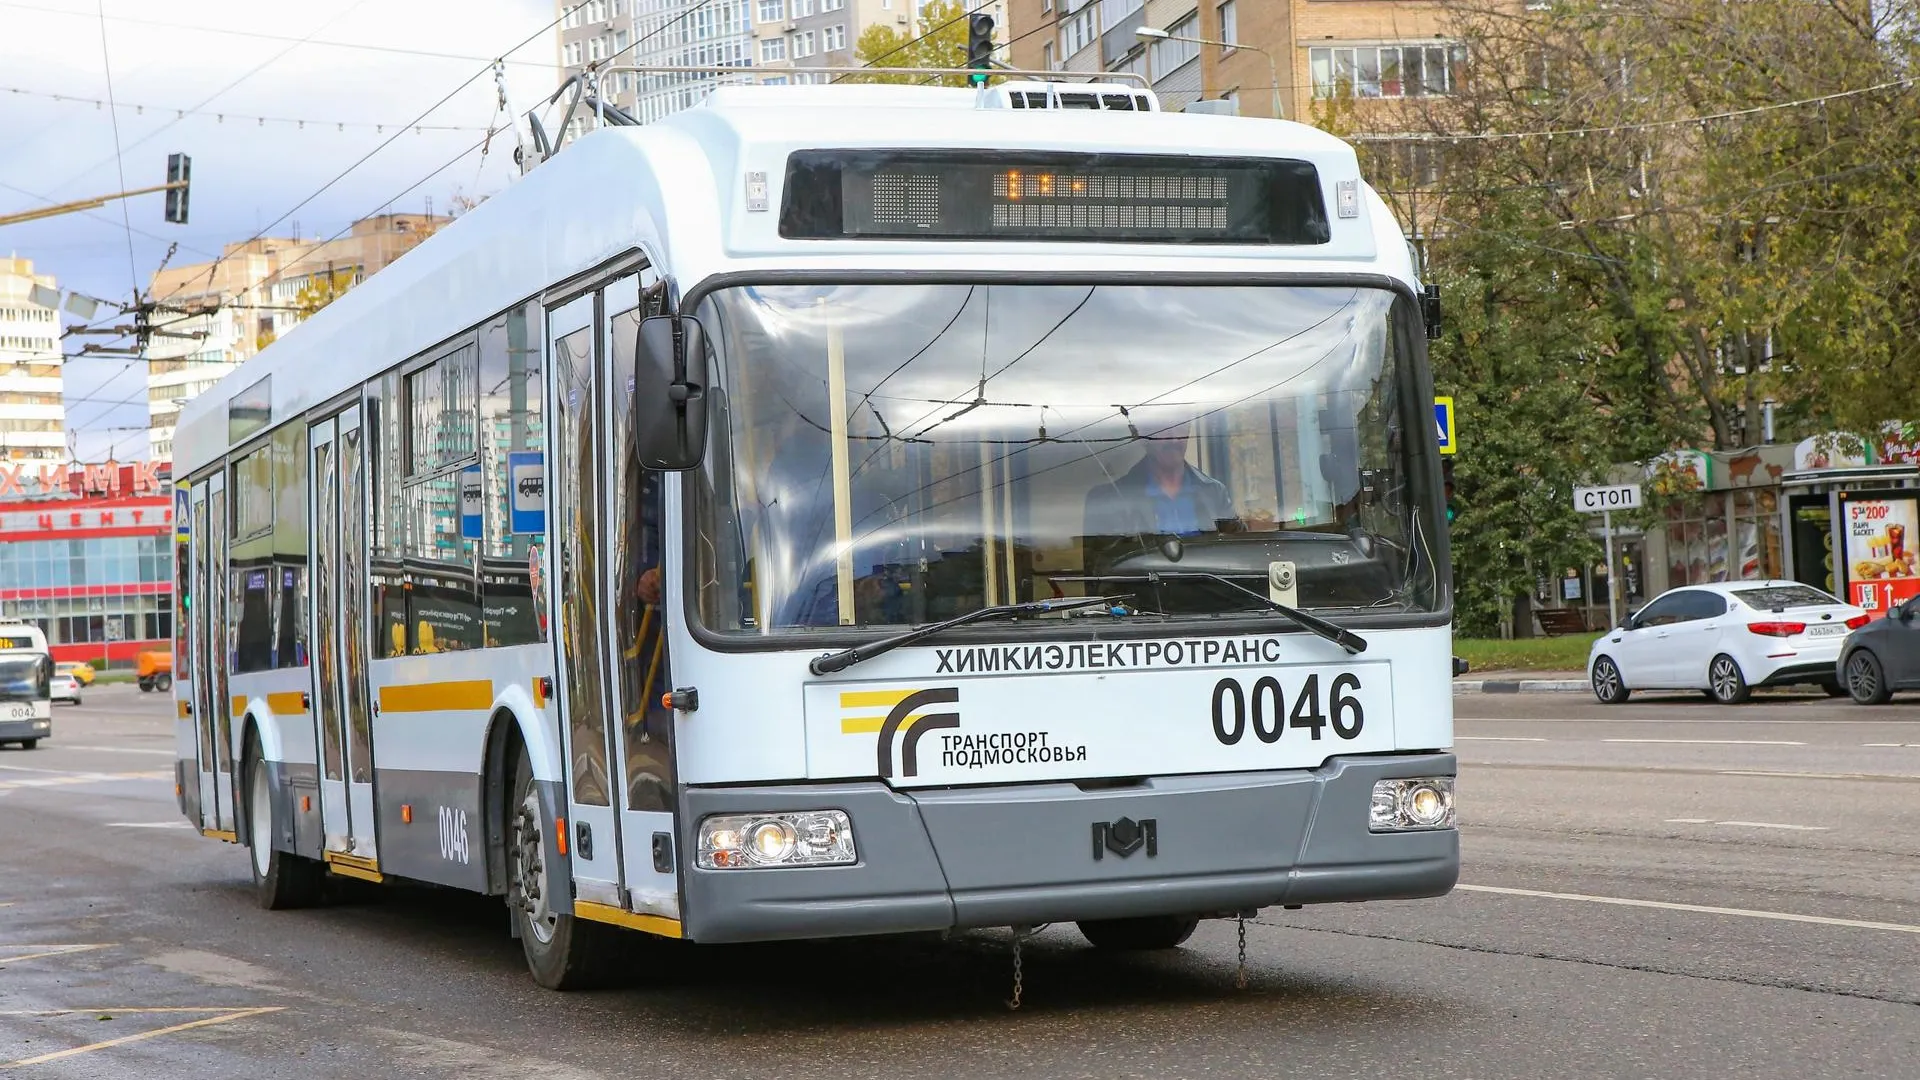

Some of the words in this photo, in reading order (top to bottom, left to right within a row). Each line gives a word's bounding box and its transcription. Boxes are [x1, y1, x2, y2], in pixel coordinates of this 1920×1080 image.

[1584, 489, 1632, 507] СТОП
[1852, 507, 1859, 520] 5
[1853, 529, 1875, 537] БАСКЕТ
[936, 638, 1280, 673] ХИМКИЭЛЕКТРОТРАНС
[12, 708, 36, 718] 0042
[1212, 672, 1364, 746] 0046
[941, 732, 1049, 751] ТРАНСПОРТ
[943, 746, 1087, 769] ПОДМОСКОВЬЯ
[439, 805, 469, 865] 0046
